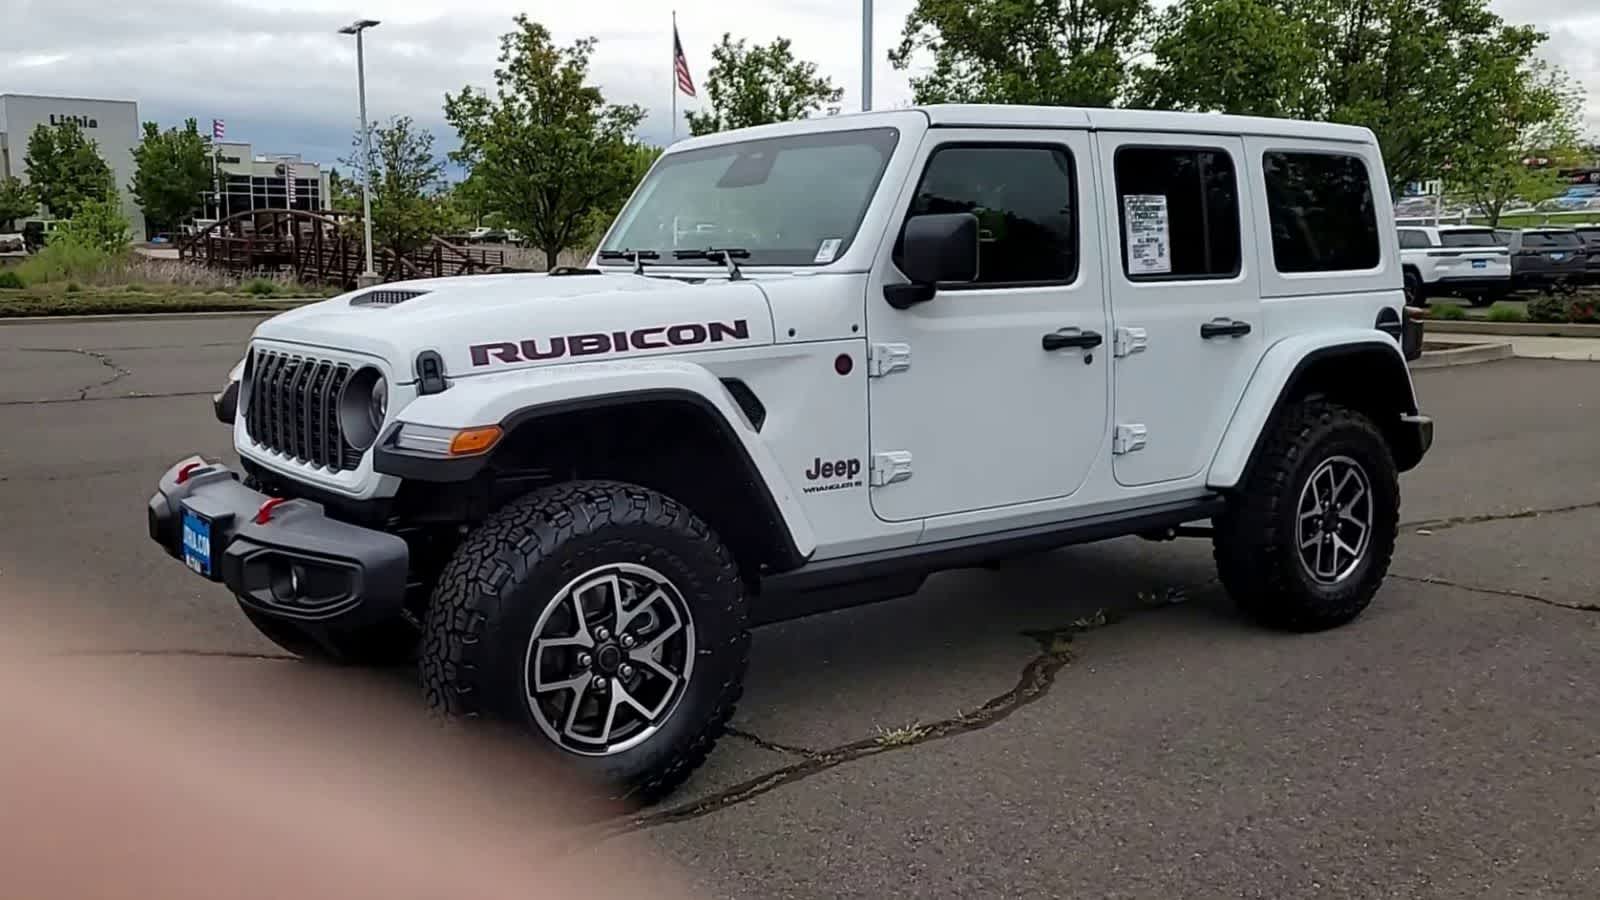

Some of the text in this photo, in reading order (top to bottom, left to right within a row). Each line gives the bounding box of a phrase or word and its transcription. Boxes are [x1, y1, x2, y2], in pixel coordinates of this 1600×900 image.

[49, 114, 98, 128] Lithia
[470, 319, 750, 367] RUBICON
[805, 457, 861, 480] Jeep
[802, 481, 853, 493] WRANGLER
